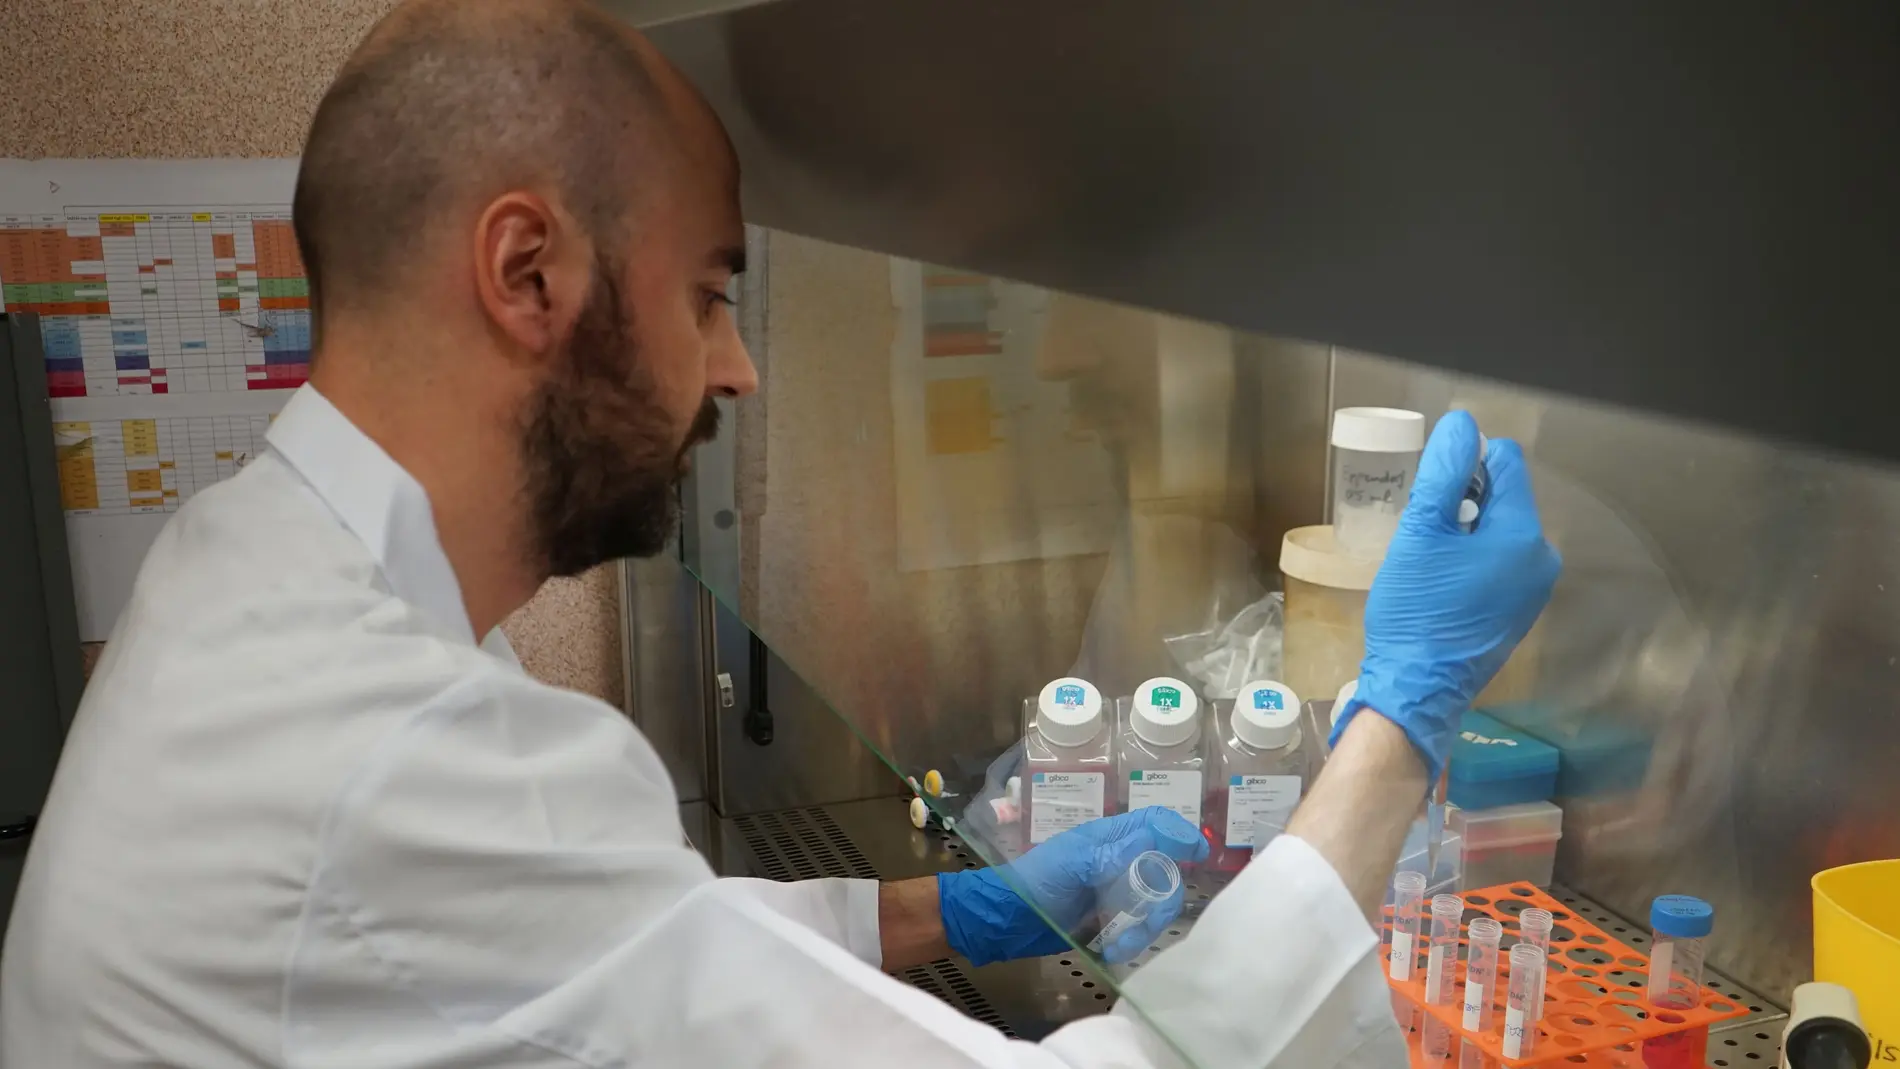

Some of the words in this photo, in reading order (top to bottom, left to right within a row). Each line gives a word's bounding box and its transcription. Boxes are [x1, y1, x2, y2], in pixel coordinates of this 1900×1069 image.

[1160, 697, 1173, 707] 1X
[1049, 774, 1069, 783] gibco
[1147, 772, 1168, 781] gibco
[1246, 778, 1267, 786] gibco
